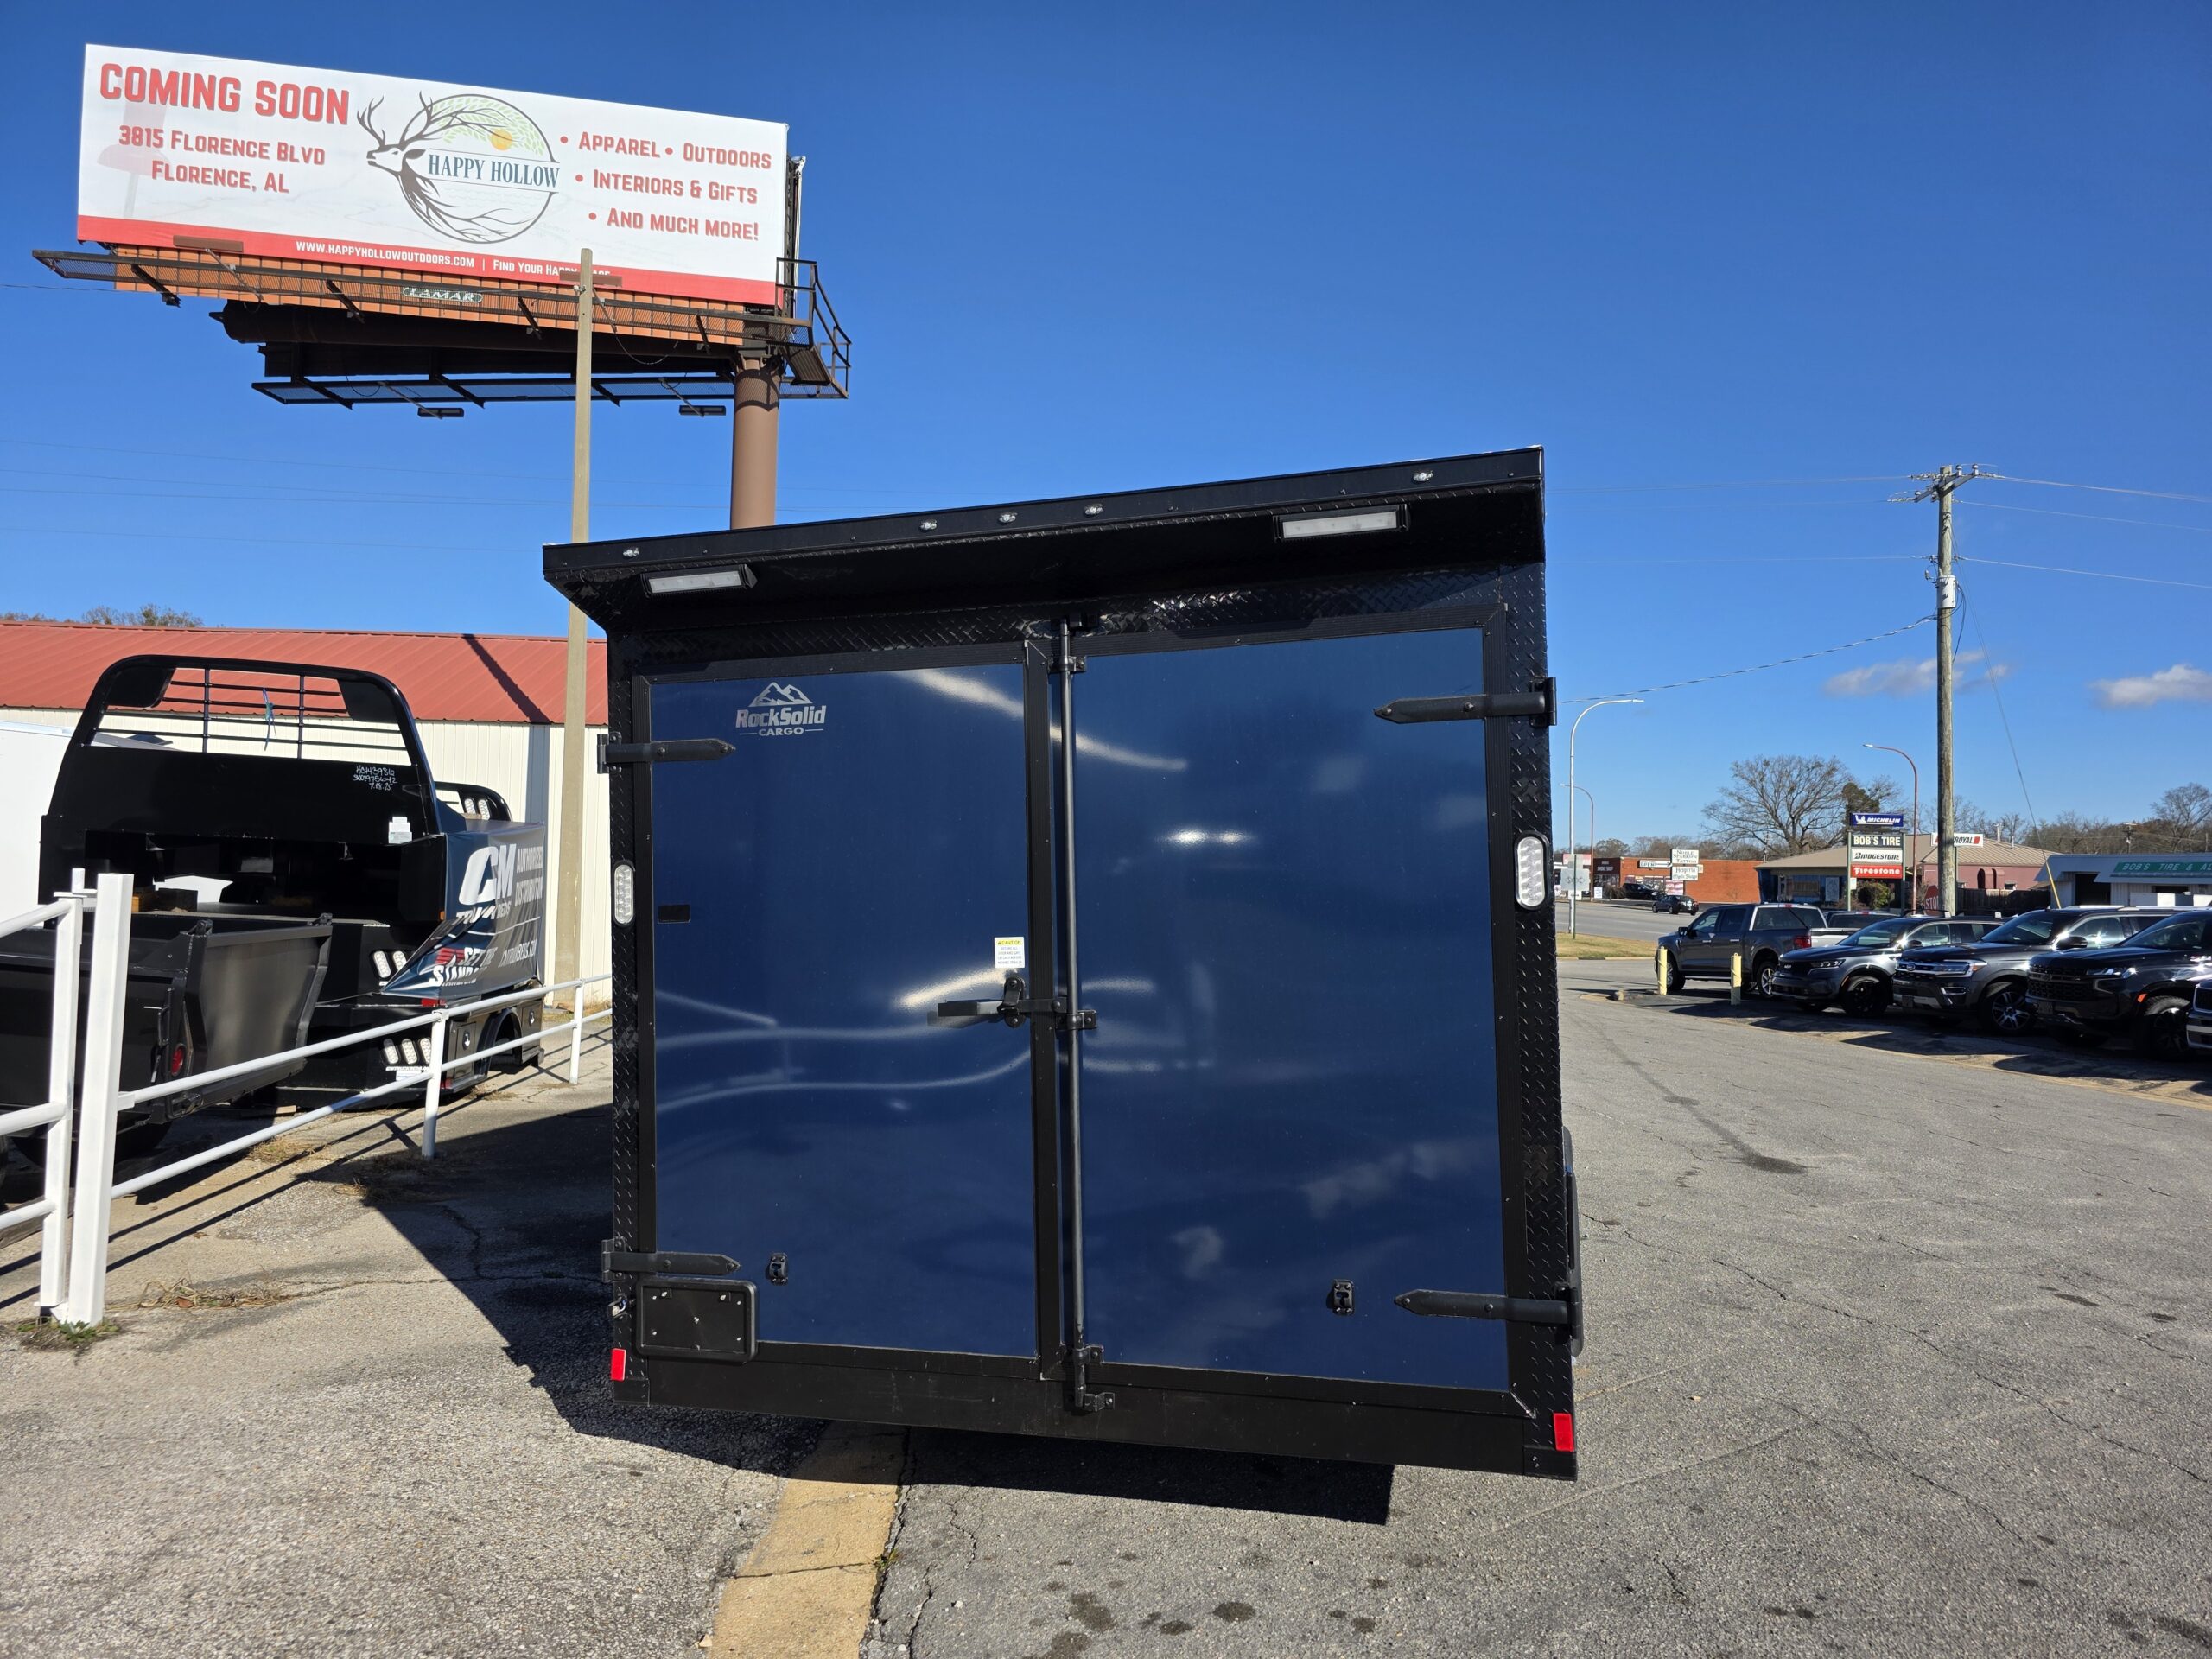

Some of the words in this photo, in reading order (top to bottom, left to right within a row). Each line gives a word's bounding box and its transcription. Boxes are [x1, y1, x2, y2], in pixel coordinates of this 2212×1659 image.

[99, 63, 242, 113] COMING
[255, 81, 350, 125] SOON
[118, 124, 164, 149] 3815
[171, 130, 270, 160] FLORENCE
[277, 142, 326, 166] BLVD
[579, 131, 661, 159] APPAREL
[683, 143, 772, 169] OUTDOORS
[151, 161, 257, 192] FLORENCE,
[264, 173, 289, 194] AL
[429, 154, 485, 181] HAPPY
[491, 161, 561, 188] HOLLOW
[594, 169, 684, 198] INTERIORS
[690, 180, 702, 199] &
[709, 181, 759, 205] GIFTS
[607, 207, 644, 229] AND
[650, 213, 699, 235] MUCH
[705, 219, 759, 241] MORE!
[296, 241, 475, 268] WWW.HAPPYHOLLOWOUTDOORS.COM
[493, 259, 515, 272] FIND
[518, 262, 543, 275] YOUR
[735, 705, 827, 728] RockSolid
[759, 727, 804, 736] CARGO
[1853, 836, 1878, 846] BOB'S
[1881, 836, 1901, 846] TIRE
[1854, 852, 1900, 861] BRIDGESTONE
[458, 843, 517, 906] CM
[1853, 867, 1901, 875] Firestone
[1925, 895, 1939, 910] STO
